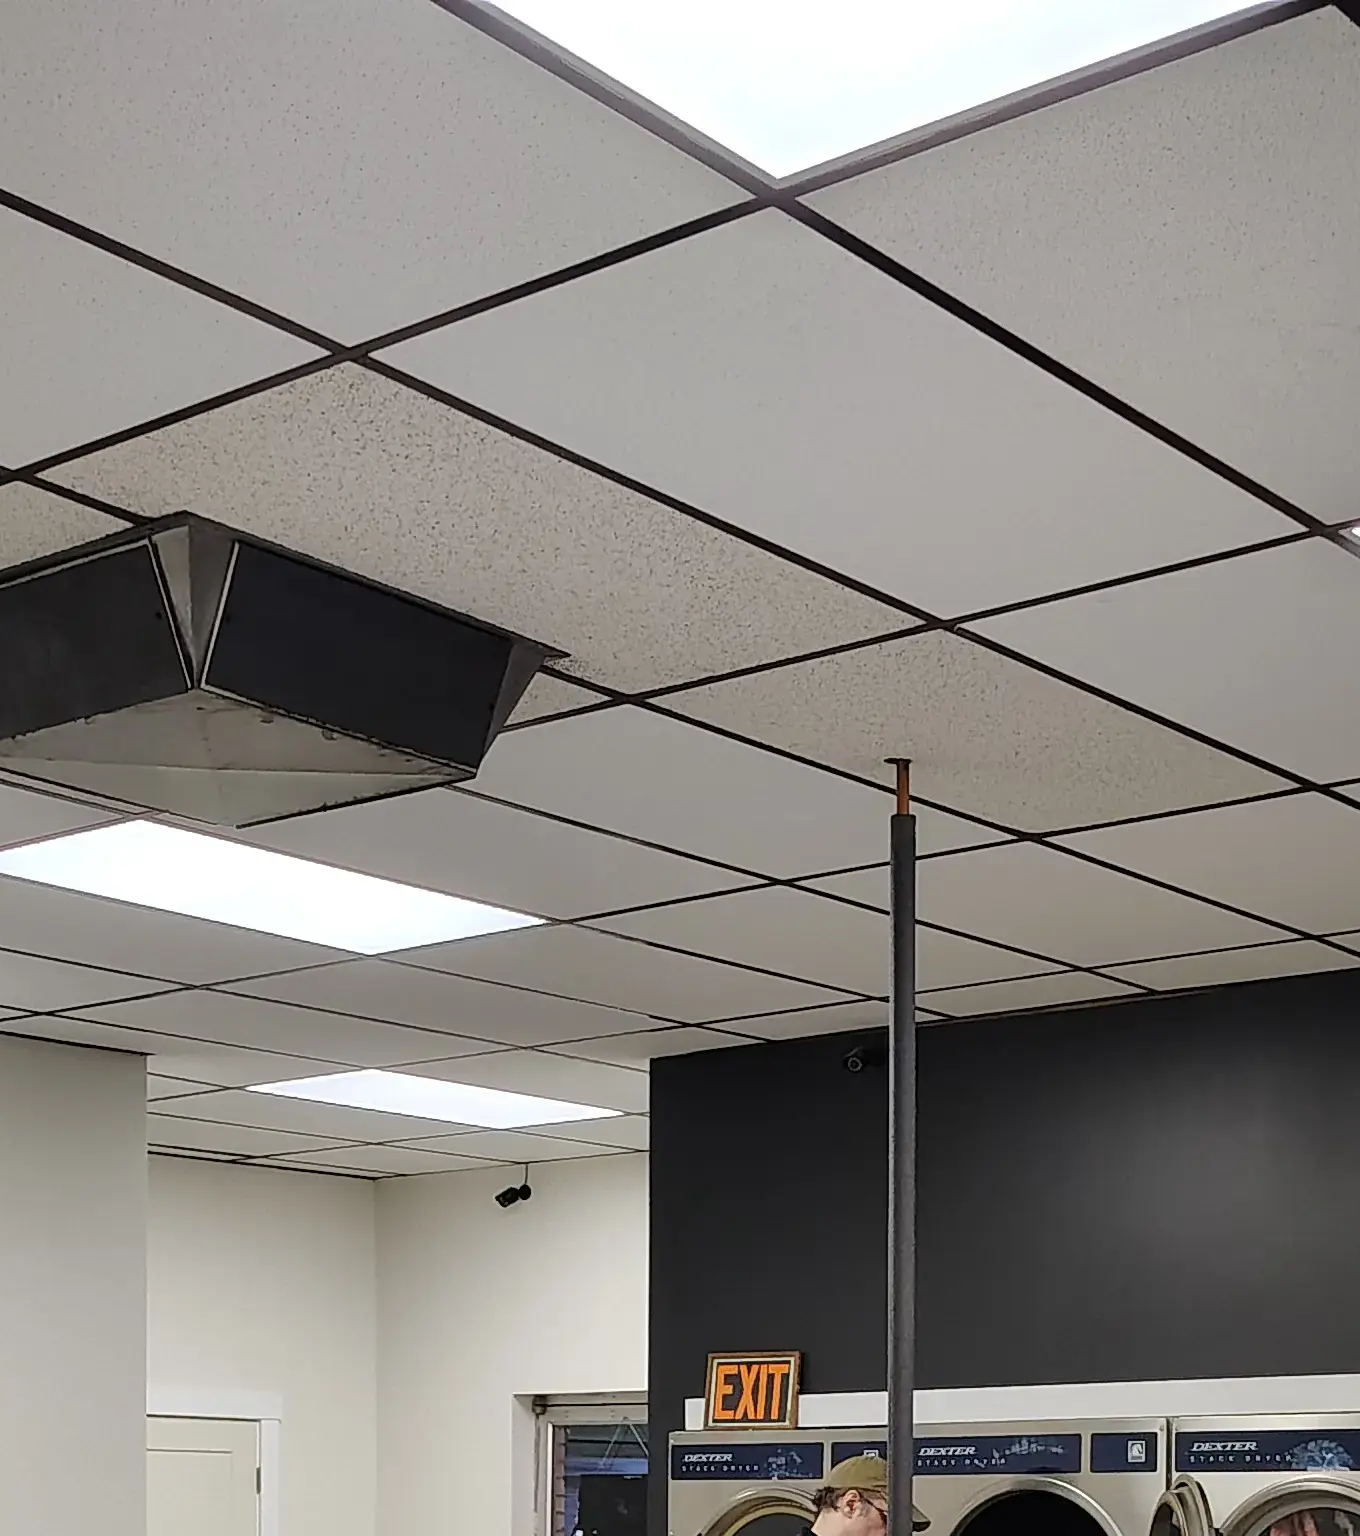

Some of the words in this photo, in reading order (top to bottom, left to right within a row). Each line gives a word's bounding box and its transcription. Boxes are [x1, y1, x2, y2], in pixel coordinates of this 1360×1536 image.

[713, 1364, 790, 1420] EXIT
[918, 1447, 978, 1456] DEXTER
[1190, 1442, 1258, 1452] DEXTER
[684, 1453, 733, 1462] DEXTER
